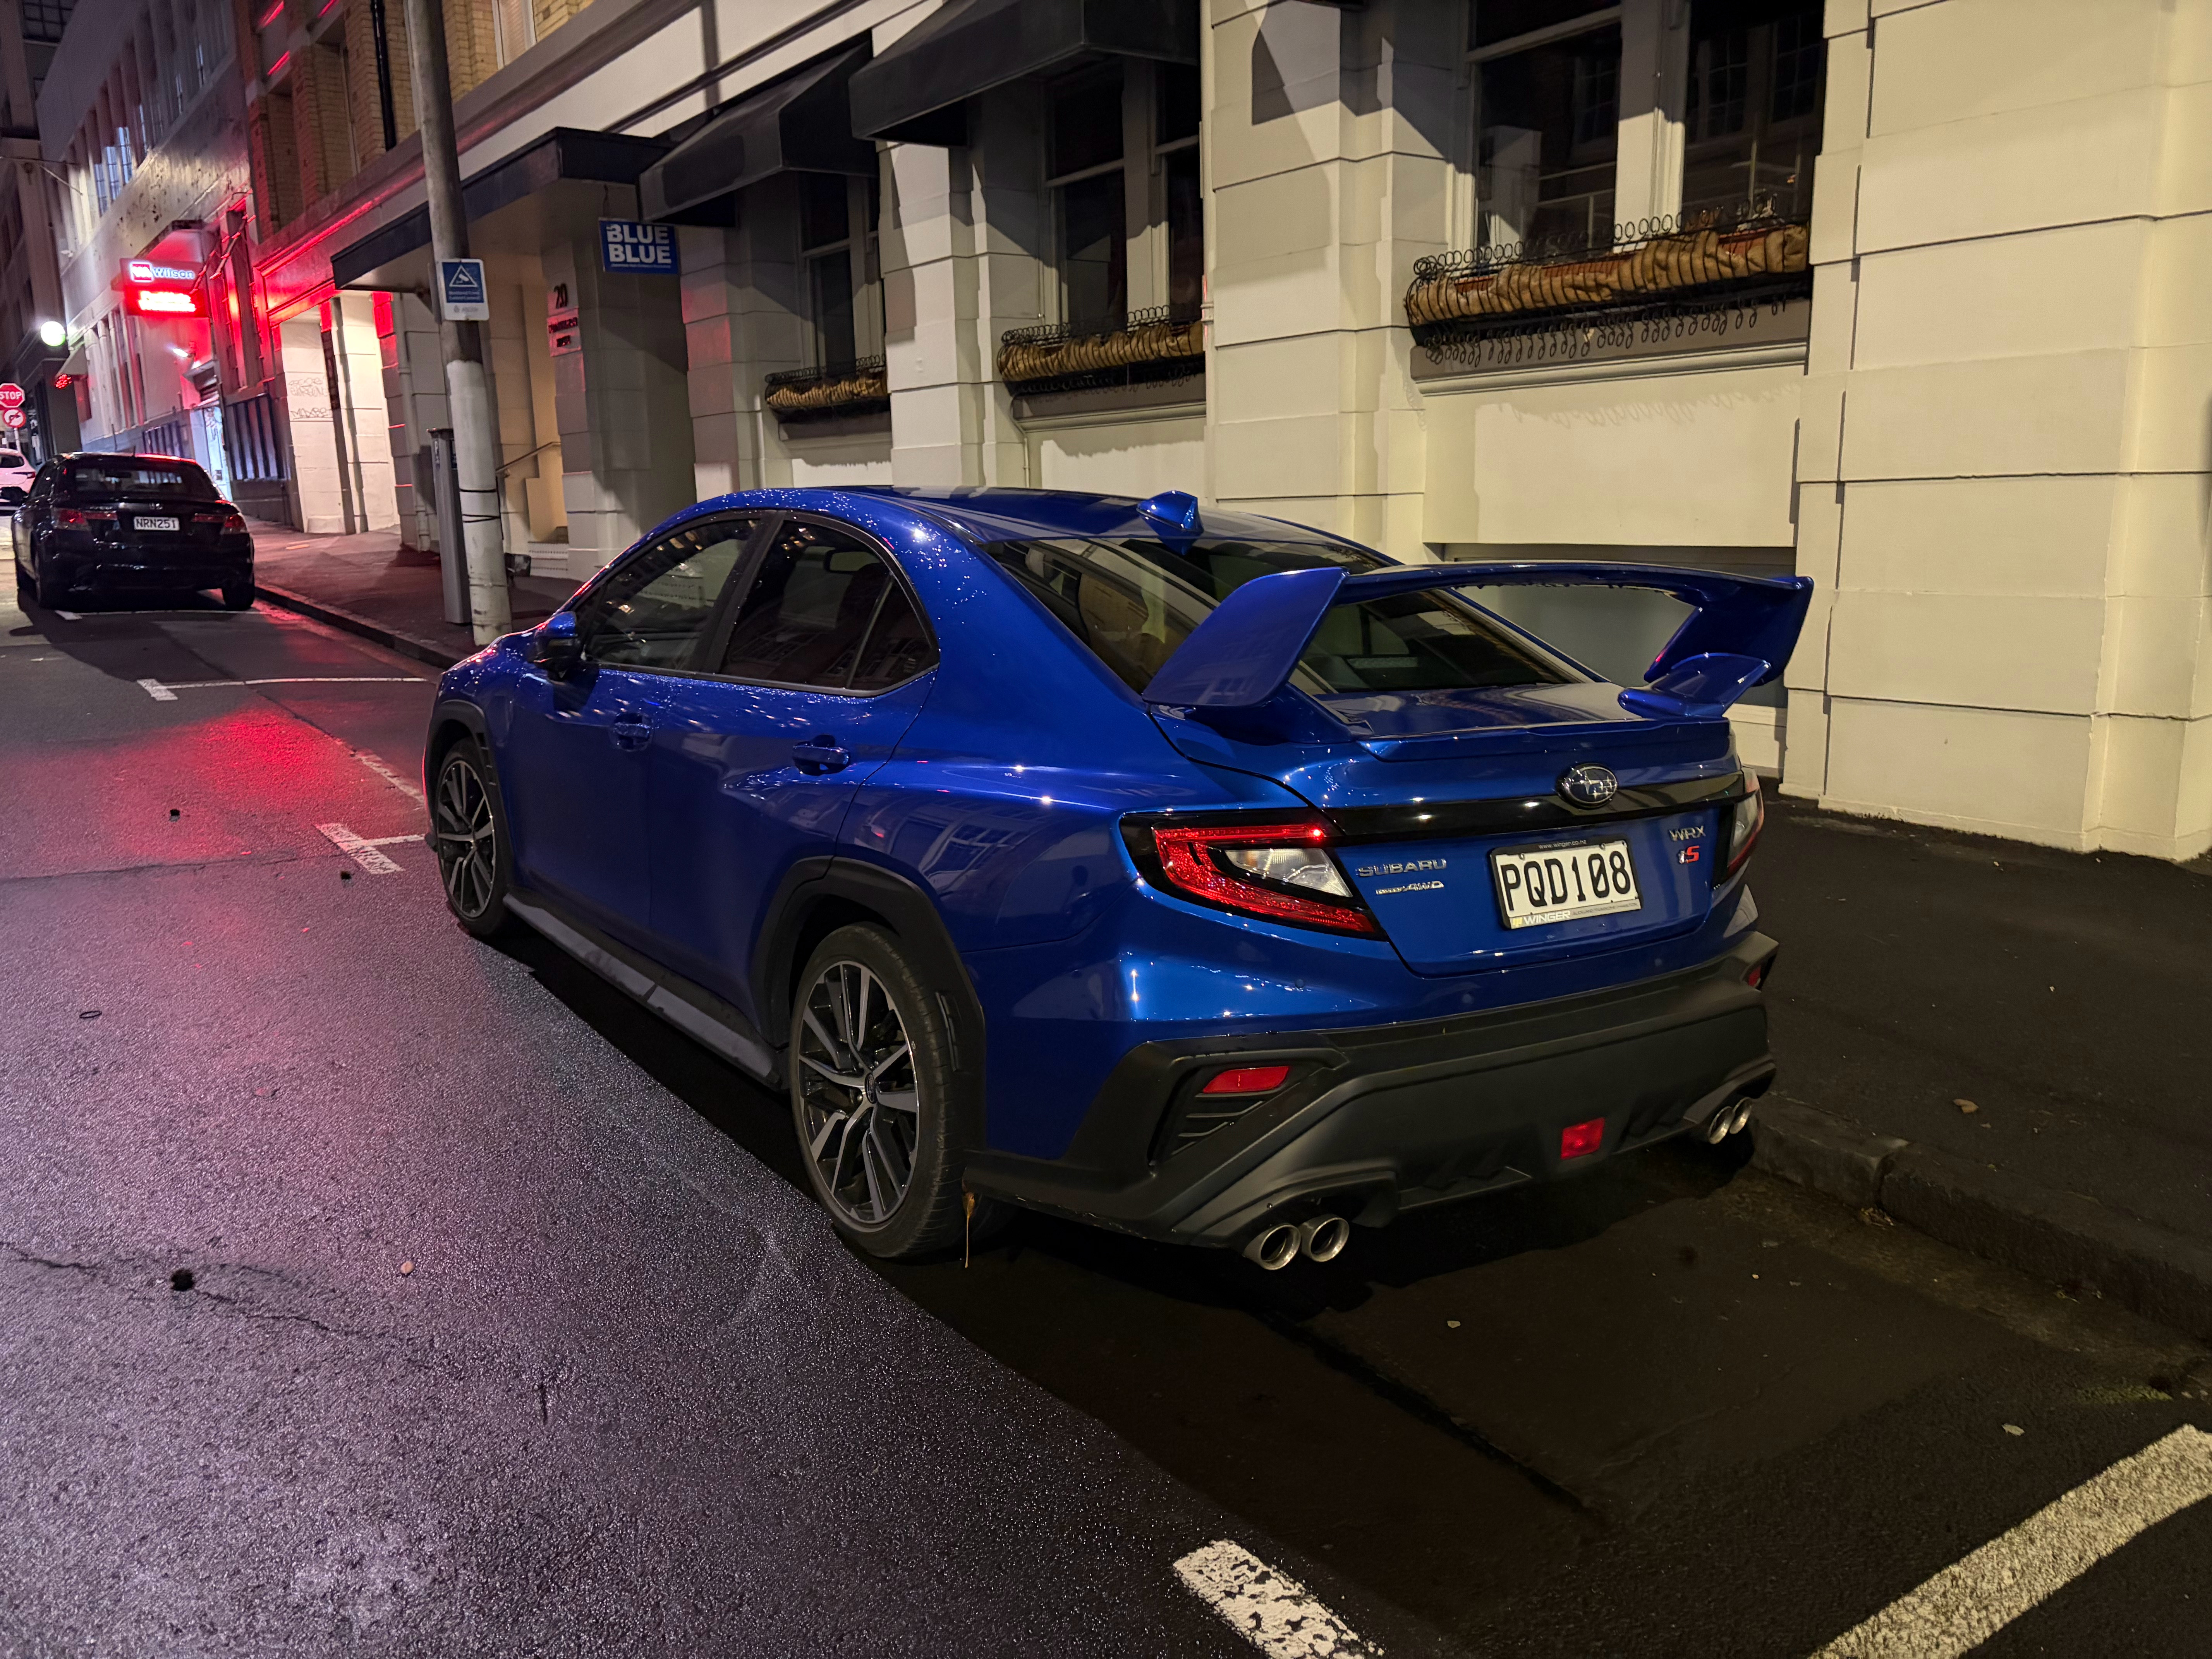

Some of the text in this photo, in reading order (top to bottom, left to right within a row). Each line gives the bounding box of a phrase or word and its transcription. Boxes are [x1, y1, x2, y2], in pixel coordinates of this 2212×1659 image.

[606, 224, 670, 244] BLUE
[608, 244, 672, 264] BLUE
[152, 267, 196, 279] Wilson
[0, 391, 22, 400] STOP
[136, 519, 175, 529] NRN251
[1668, 825, 1706, 842] WRX
[1355, 858, 1447, 877] SUBARU
[1403, 880, 1444, 892] AWD
[1500, 850, 1631, 911] PQD108
[1523, 910, 1571, 925] WINGER
